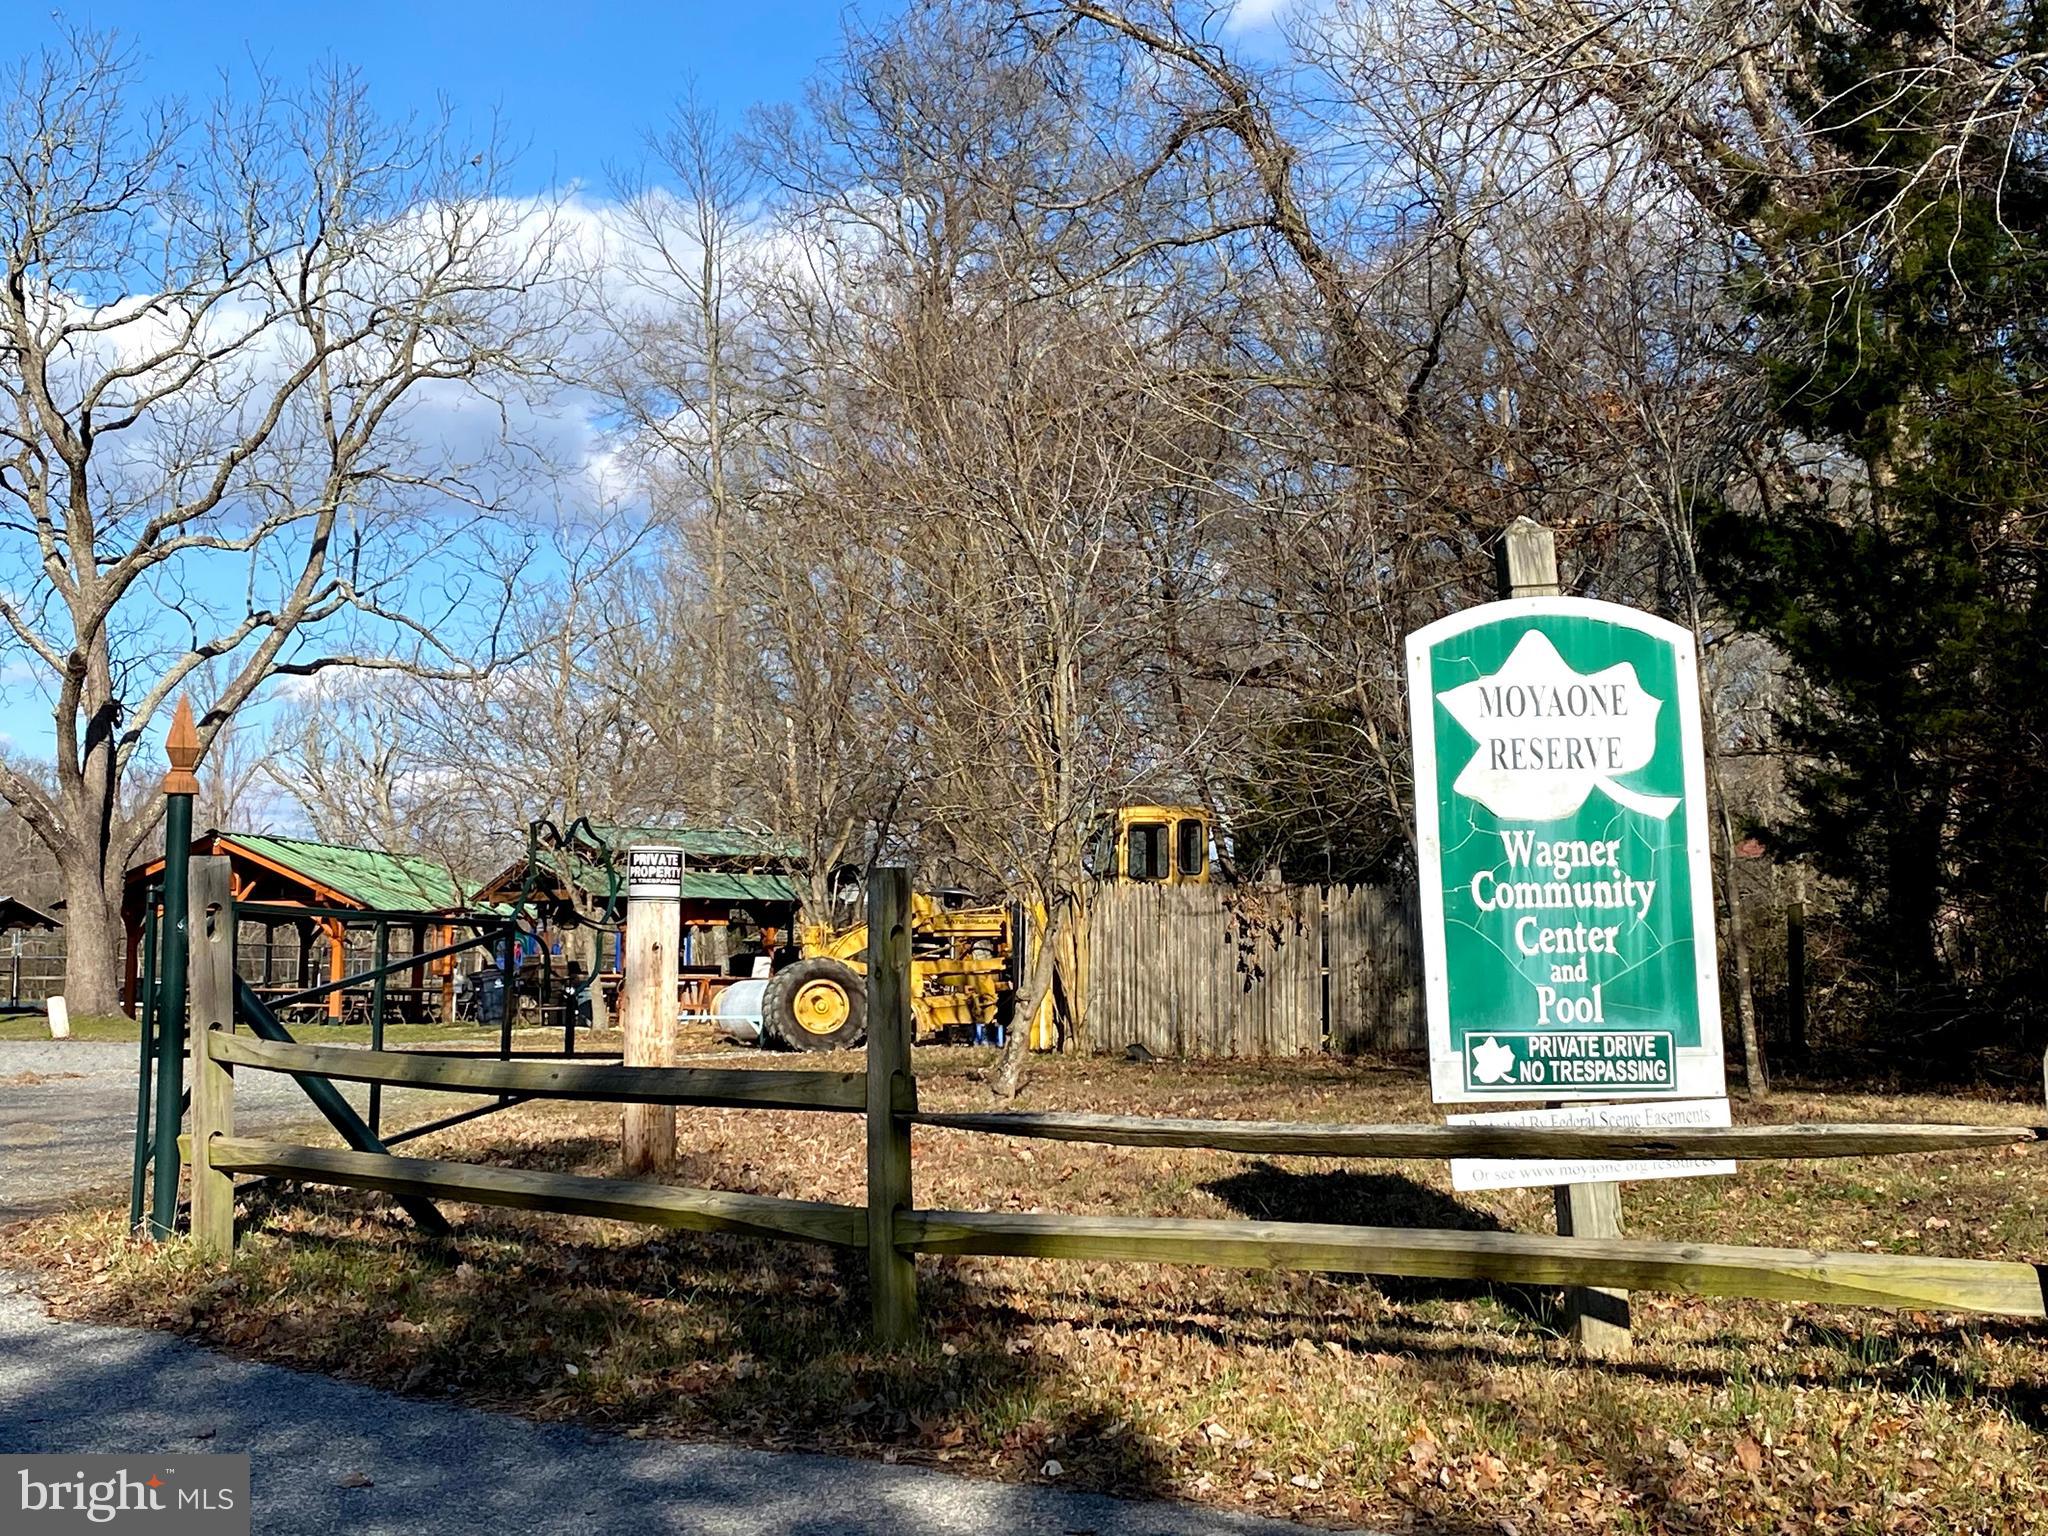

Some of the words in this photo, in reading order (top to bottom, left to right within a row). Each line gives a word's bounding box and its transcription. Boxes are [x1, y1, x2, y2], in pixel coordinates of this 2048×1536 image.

[1479, 684, 1628, 717] MOYAONE
[1489, 737, 1623, 770] RESERVE
[633, 854, 678, 865] PRIVATE
[1500, 829, 1622, 879] Wagner
[630, 866, 681, 878] PROPERTY
[1471, 869, 1657, 920] Community
[1514, 916, 1622, 955] Center
[1550, 957, 1588, 983] and
[1534, 984, 1605, 1026] Pool
[1528, 1036, 1600, 1058] PRIVATE
[1603, 1036, 1657, 1058] DRIVE
[1519, 1060, 1545, 1083] NO
[1549, 1059, 1667, 1083] TRESPASSING
[1599, 1110, 1642, 1128] Scenic
[1645, 1108, 1711, 1126] Easements
[1472, 1169, 1488, 1182] Or
[1494, 1169, 1516, 1181] see
